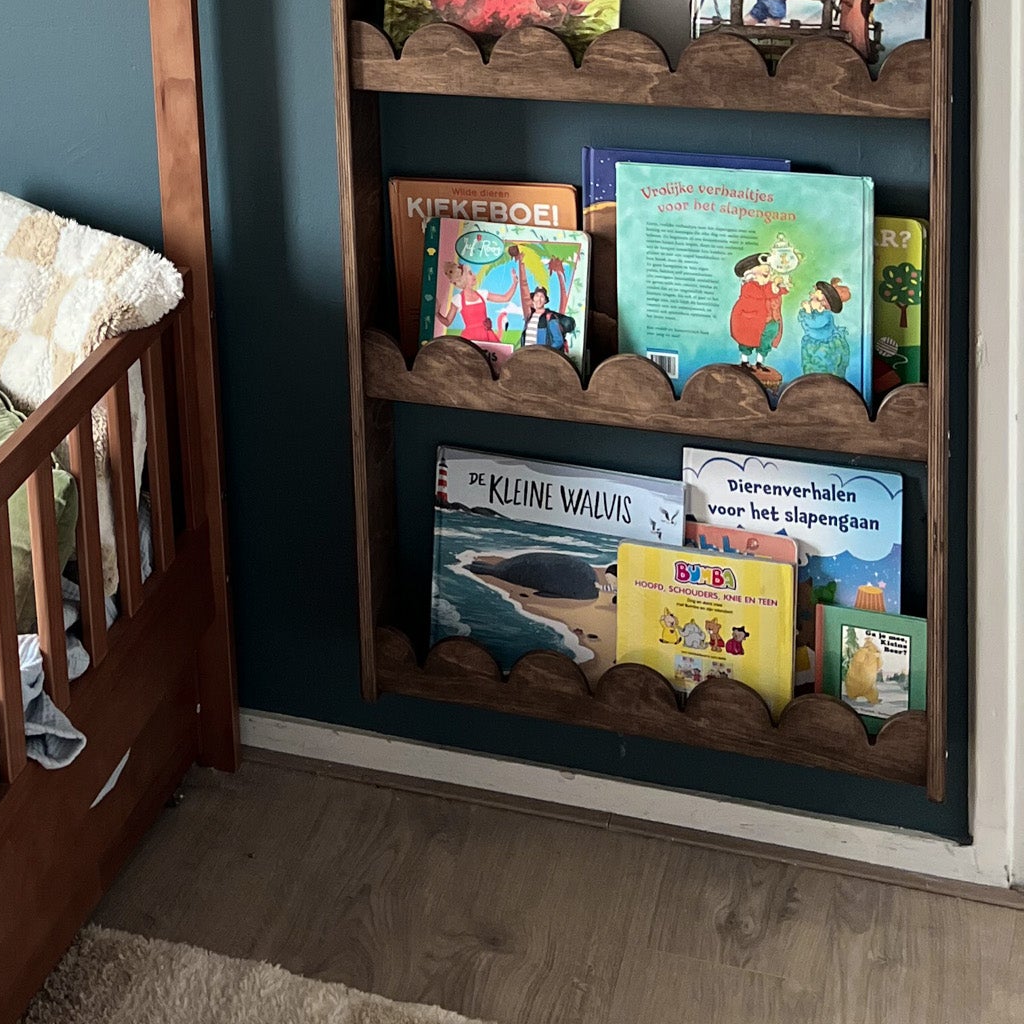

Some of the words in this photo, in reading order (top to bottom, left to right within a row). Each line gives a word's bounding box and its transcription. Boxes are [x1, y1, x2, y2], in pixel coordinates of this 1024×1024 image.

[452, 187, 477, 197] Wilde
[480, 188, 510, 198] dieren
[640, 181, 694, 199] Vrolijke
[698, 183, 774, 204] verhaaltjes
[407, 197, 559, 227] KIEKEBOE!
[657, 201, 689, 213] voor
[693, 198, 715, 212] het
[719, 202, 797, 224] slapengaan
[875, 229, 911, 248] R?
[468, 472, 486, 486] DE
[489, 474, 553, 510] KLEINE
[560, 484, 631, 524] WALVIS
[727, 479, 856, 502] Dierenverhalen
[708, 503, 745, 517] voor
[750, 501, 779, 522] het
[784, 506, 879, 533] slapengaan
[675, 561, 736, 590] BUMBA
[635, 580, 666, 592] HOOFD,
[668, 586, 720, 601] SCHOUDERS,
[723, 593, 742, 603] KNIE
[744, 596, 755, 604] EN
[758, 597, 778, 607] TEEN
